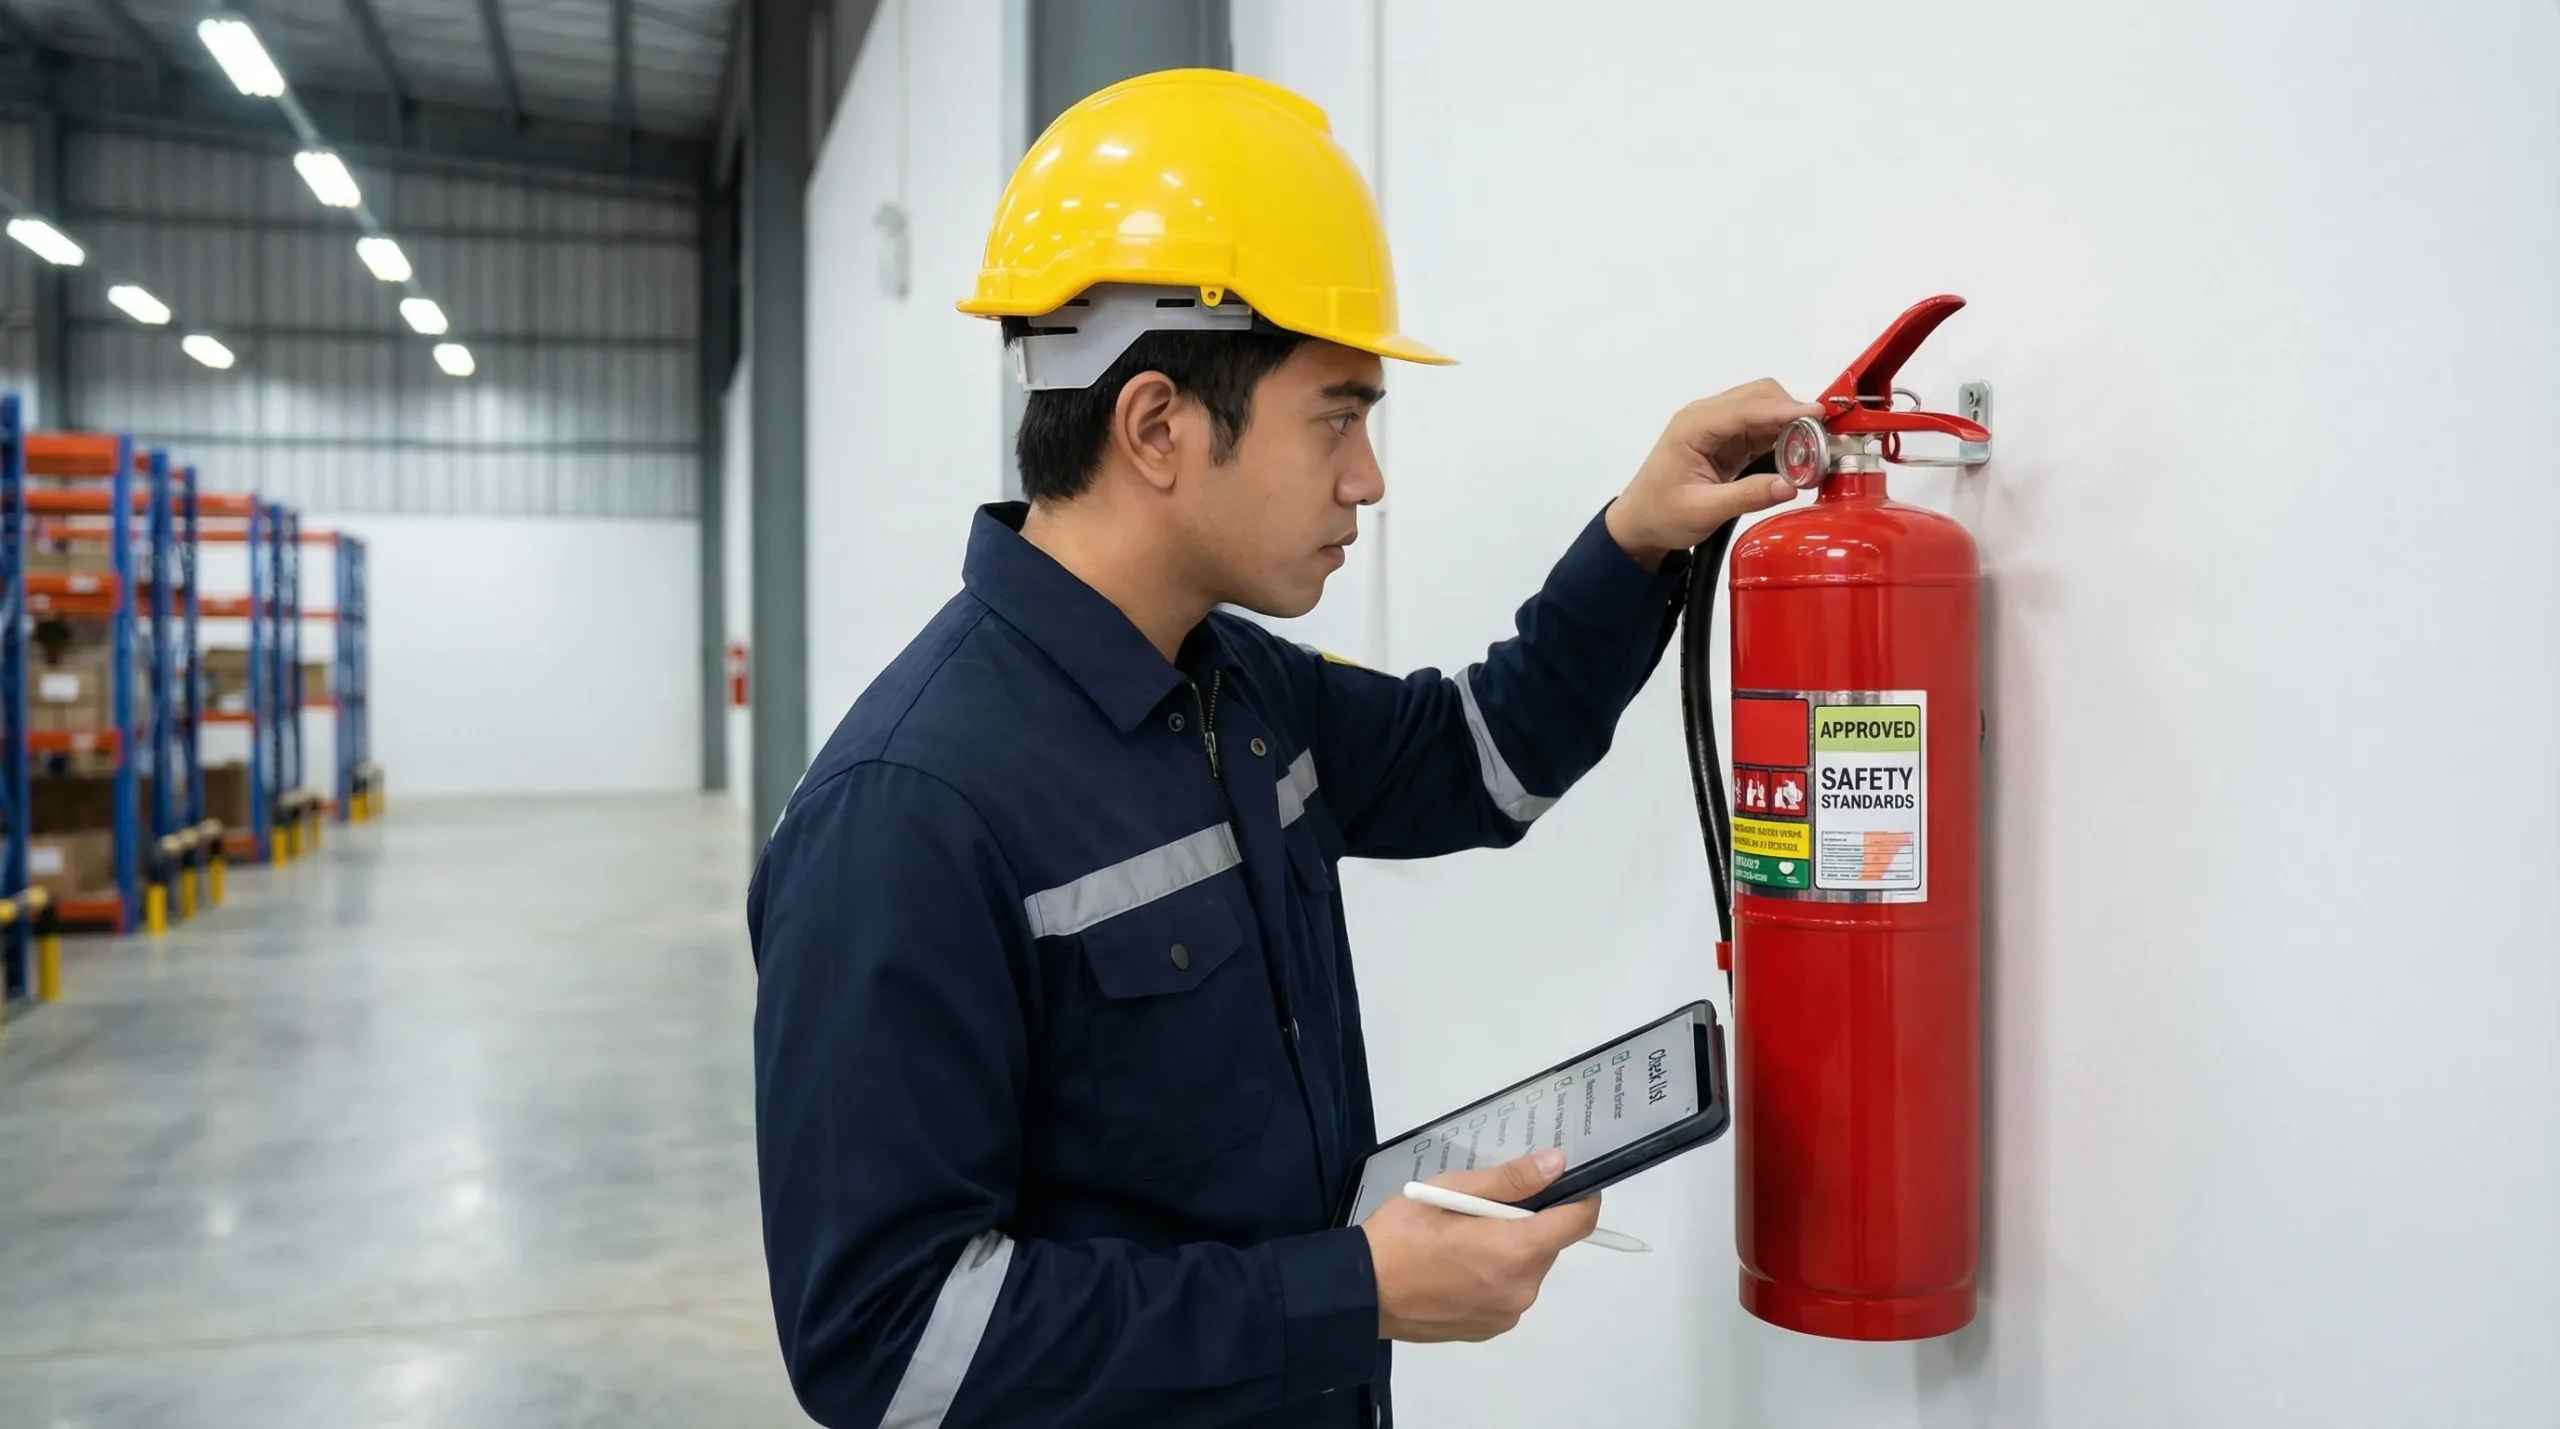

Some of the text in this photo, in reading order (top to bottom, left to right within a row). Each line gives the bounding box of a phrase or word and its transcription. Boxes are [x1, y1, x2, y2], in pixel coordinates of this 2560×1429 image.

[1820, 721, 1916, 739] APPROVED
[1821, 767, 1914, 791] SAFETY
[1821, 794, 1915, 809] STANDARDS
[1648, 1048, 1668, 1084] Check
